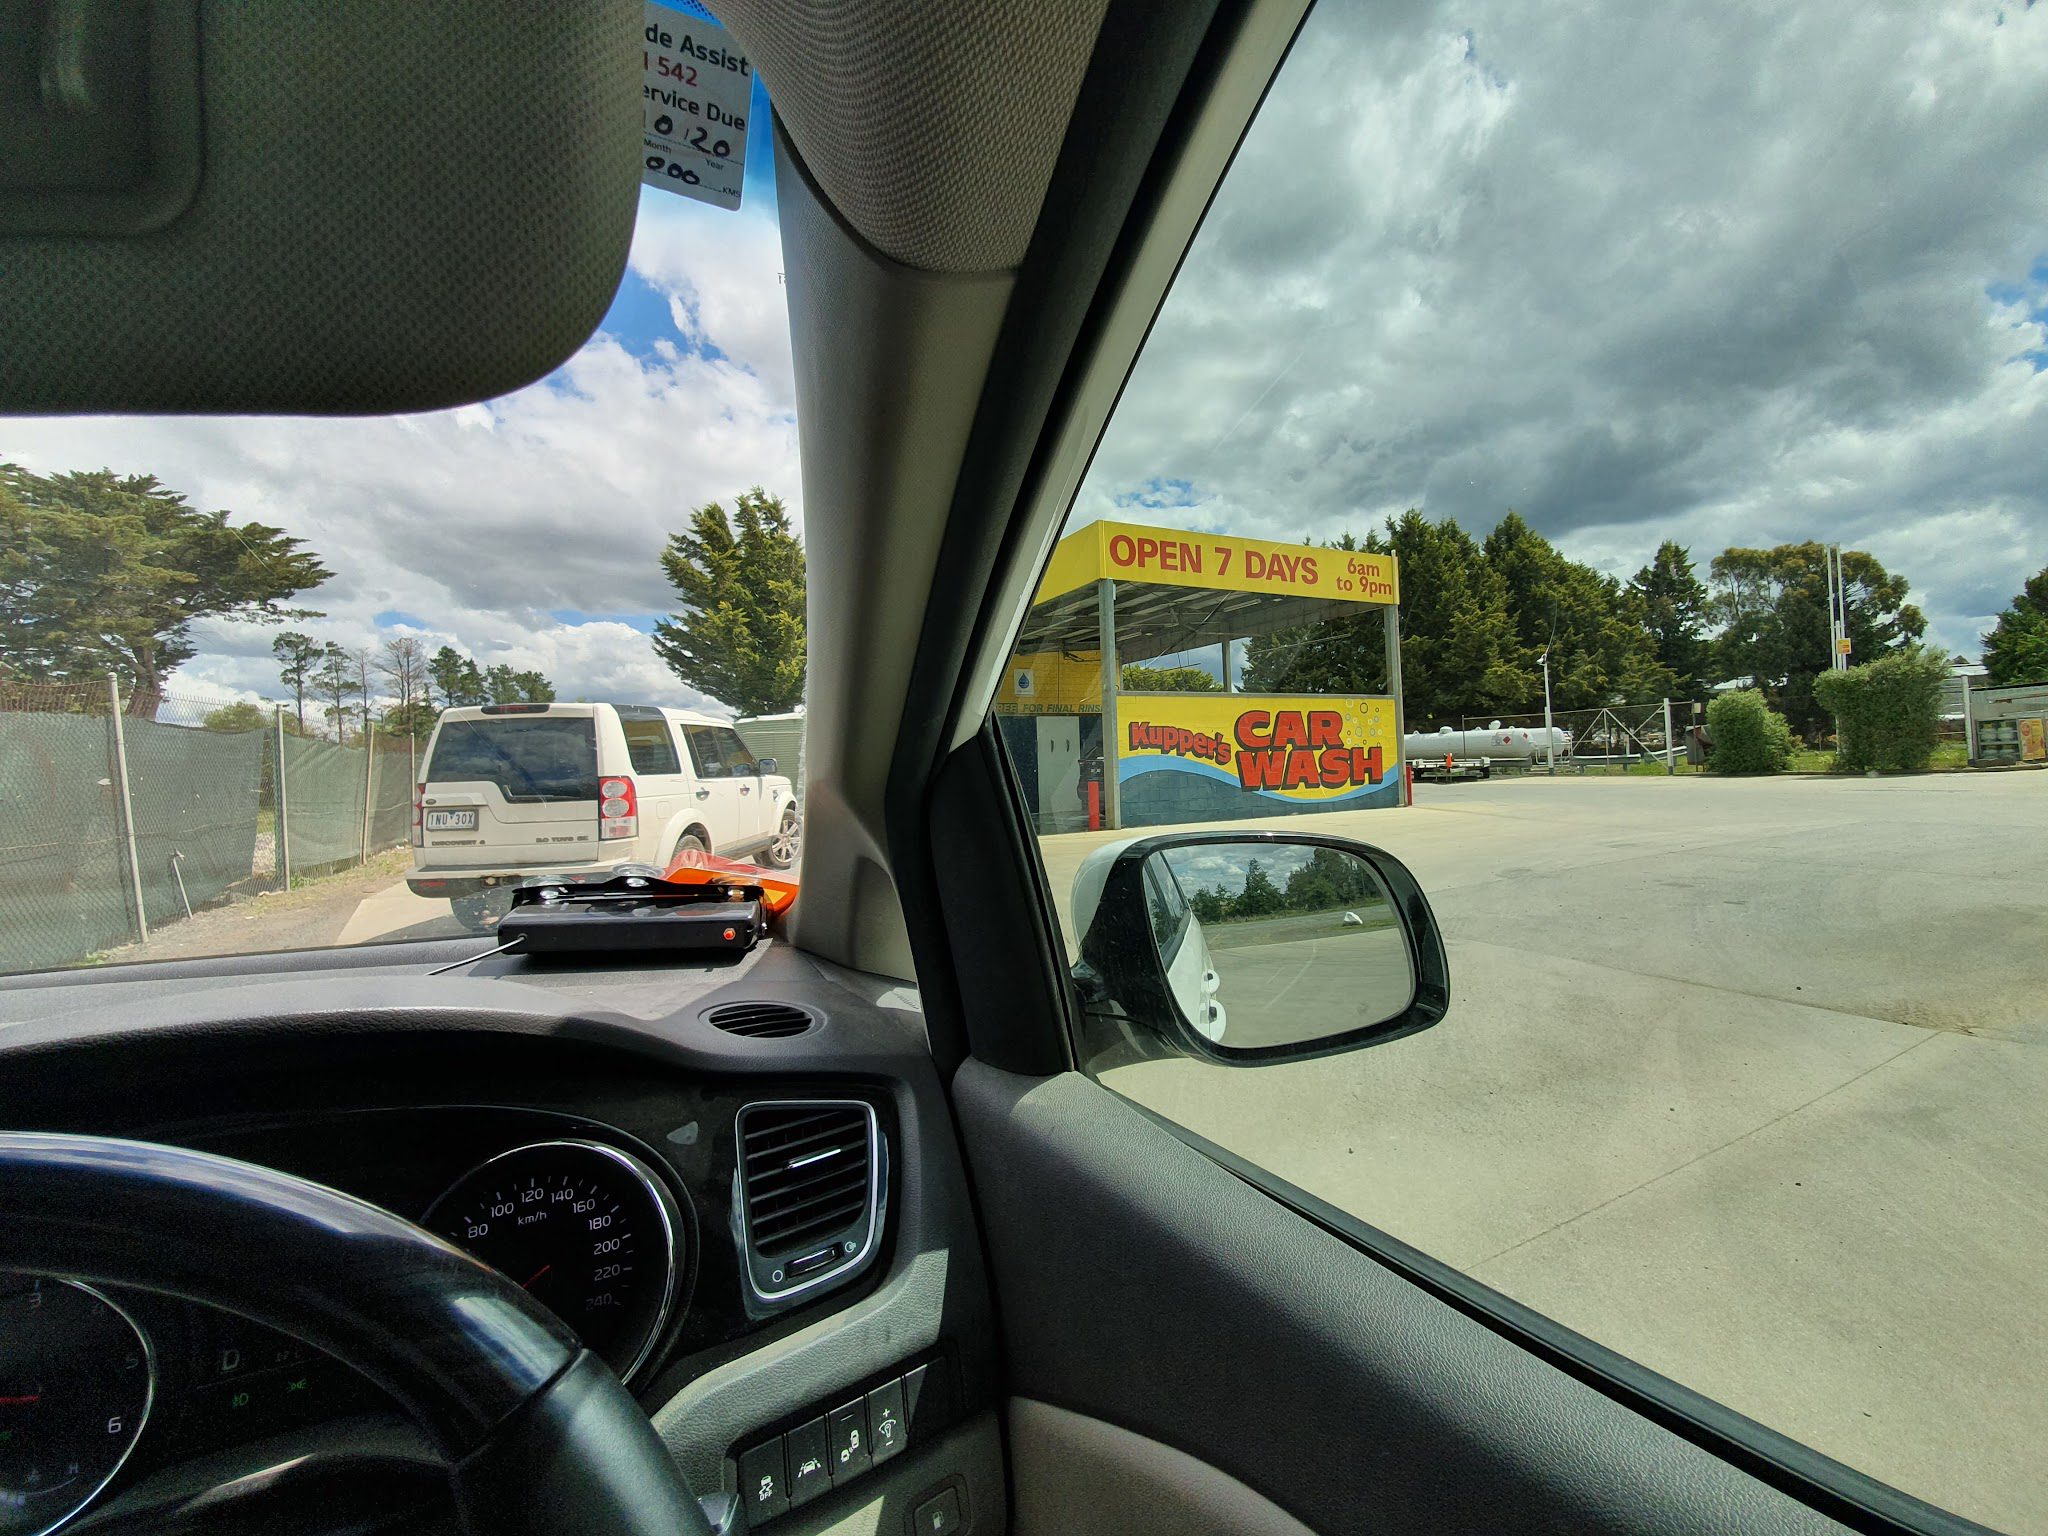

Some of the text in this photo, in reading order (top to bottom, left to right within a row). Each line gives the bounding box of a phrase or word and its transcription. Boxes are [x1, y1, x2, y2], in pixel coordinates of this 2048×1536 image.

[679, 35, 749, 76] Assist
[658, 56, 697, 87] 542
[707, 103, 745, 131] Due
[690, 127, 730, 157] 20
[705, 158, 724, 170] Year
[722, 187, 742, 198] KMS
[1109, 534, 1319, 585] OPEN 7 DAYS
[1347, 557, 1380, 577] 6am
[1336, 576, 1392, 598] to 9pm
[1022, 703, 1043, 712] FOR
[1046, 703, 1075, 712] FINAL
[1078, 703, 1103, 712] RINS
[1234, 710, 1344, 749] CAR
[1129, 721, 1231, 765] Kupper's
[1235, 746, 1383, 792] WASH
[521, 1188, 544, 1203] 120
[551, 1188, 574, 1203] 140
[490, 1202, 514, 1218] 100
[572, 1199, 596, 1214] 160
[517, 1210, 547, 1226] km/h
[588, 1215, 612, 1231] 180
[468, 1224, 488, 1238] 80
[593, 1238, 620, 1255] 200
[594, 1264, 621, 1281] 220
[586, 1293, 612, 1311] 240
[222, 1348, 240, 1371] D
[107, 1416, 122, 1434] 6
[759, 1490, 773, 1502] OFF
